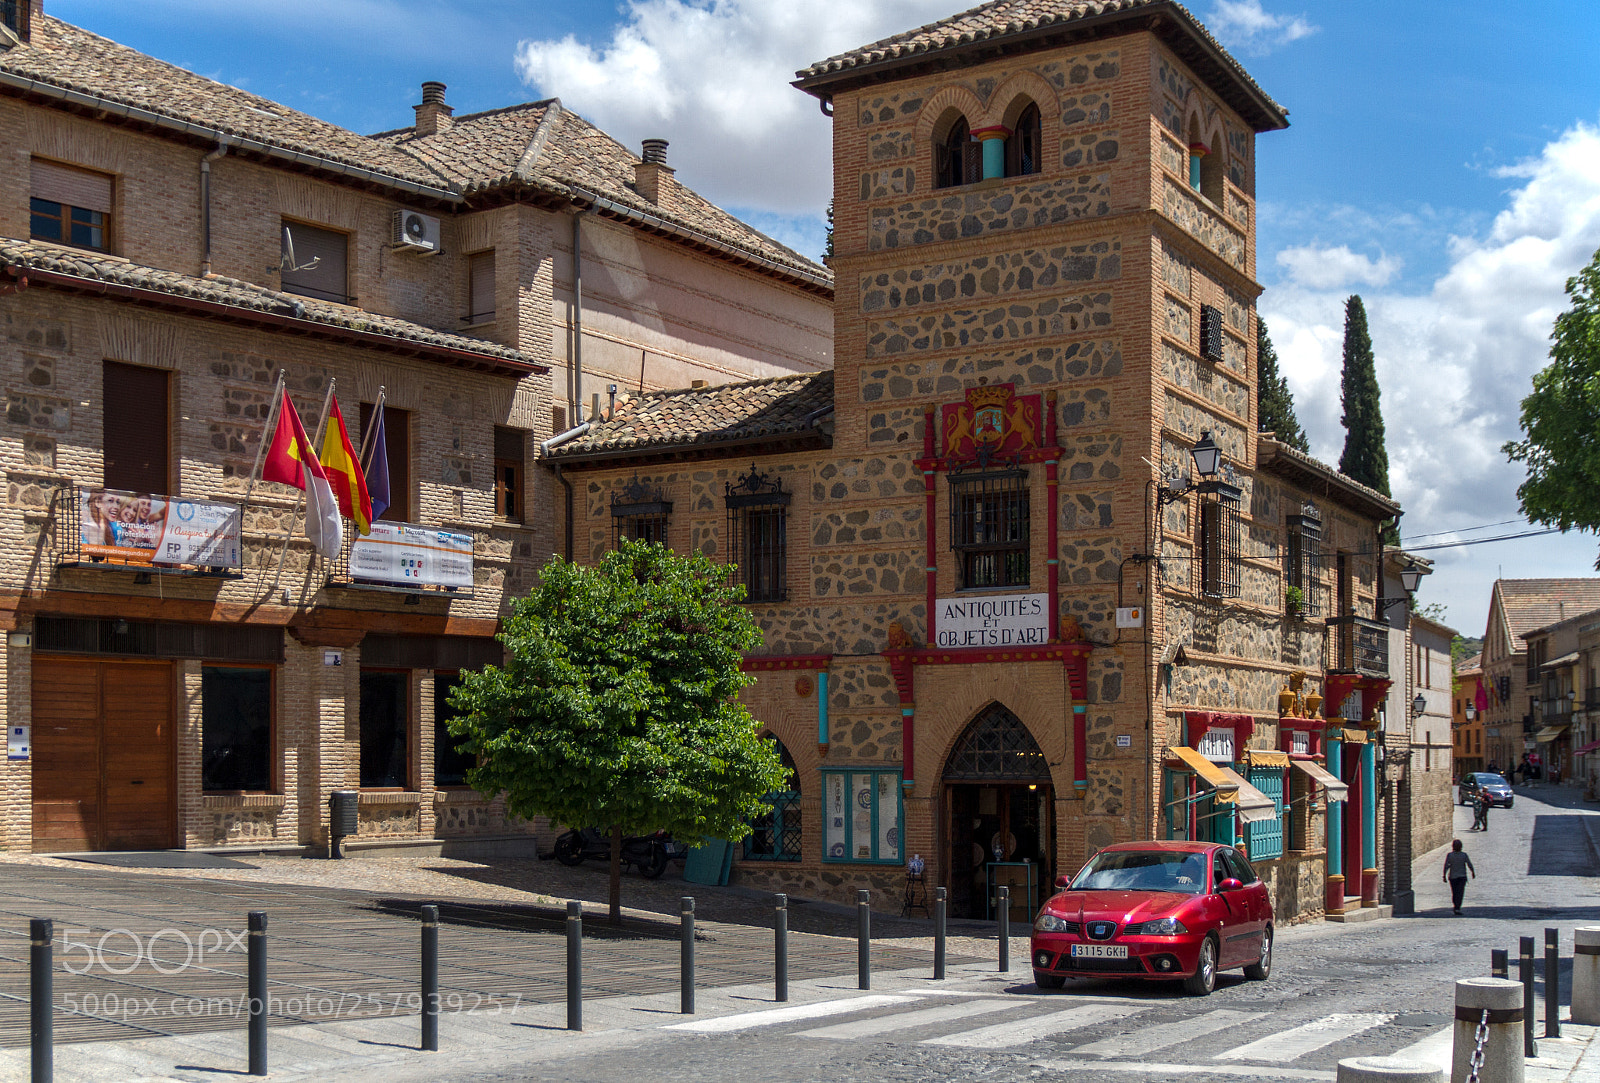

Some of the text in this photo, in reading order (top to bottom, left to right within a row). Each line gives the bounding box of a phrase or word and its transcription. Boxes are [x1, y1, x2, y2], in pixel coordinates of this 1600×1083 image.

[117, 520, 156, 531] Formación
[370, 526, 390, 534] ámara
[117, 529, 156, 539] Profesional
[204, 528, 212, 538] tu
[405, 528, 426, 536] Microsoft
[438, 532, 452, 543] SAP
[167, 543, 181, 553] FP
[188, 544, 200, 552] 925
[944, 596, 1041, 619] ANTIQUITÉS
[983, 619, 1001, 628] ET
[939, 629, 998, 646] OBJETS
[1077, 945, 1126, 957] 3115 GKH
